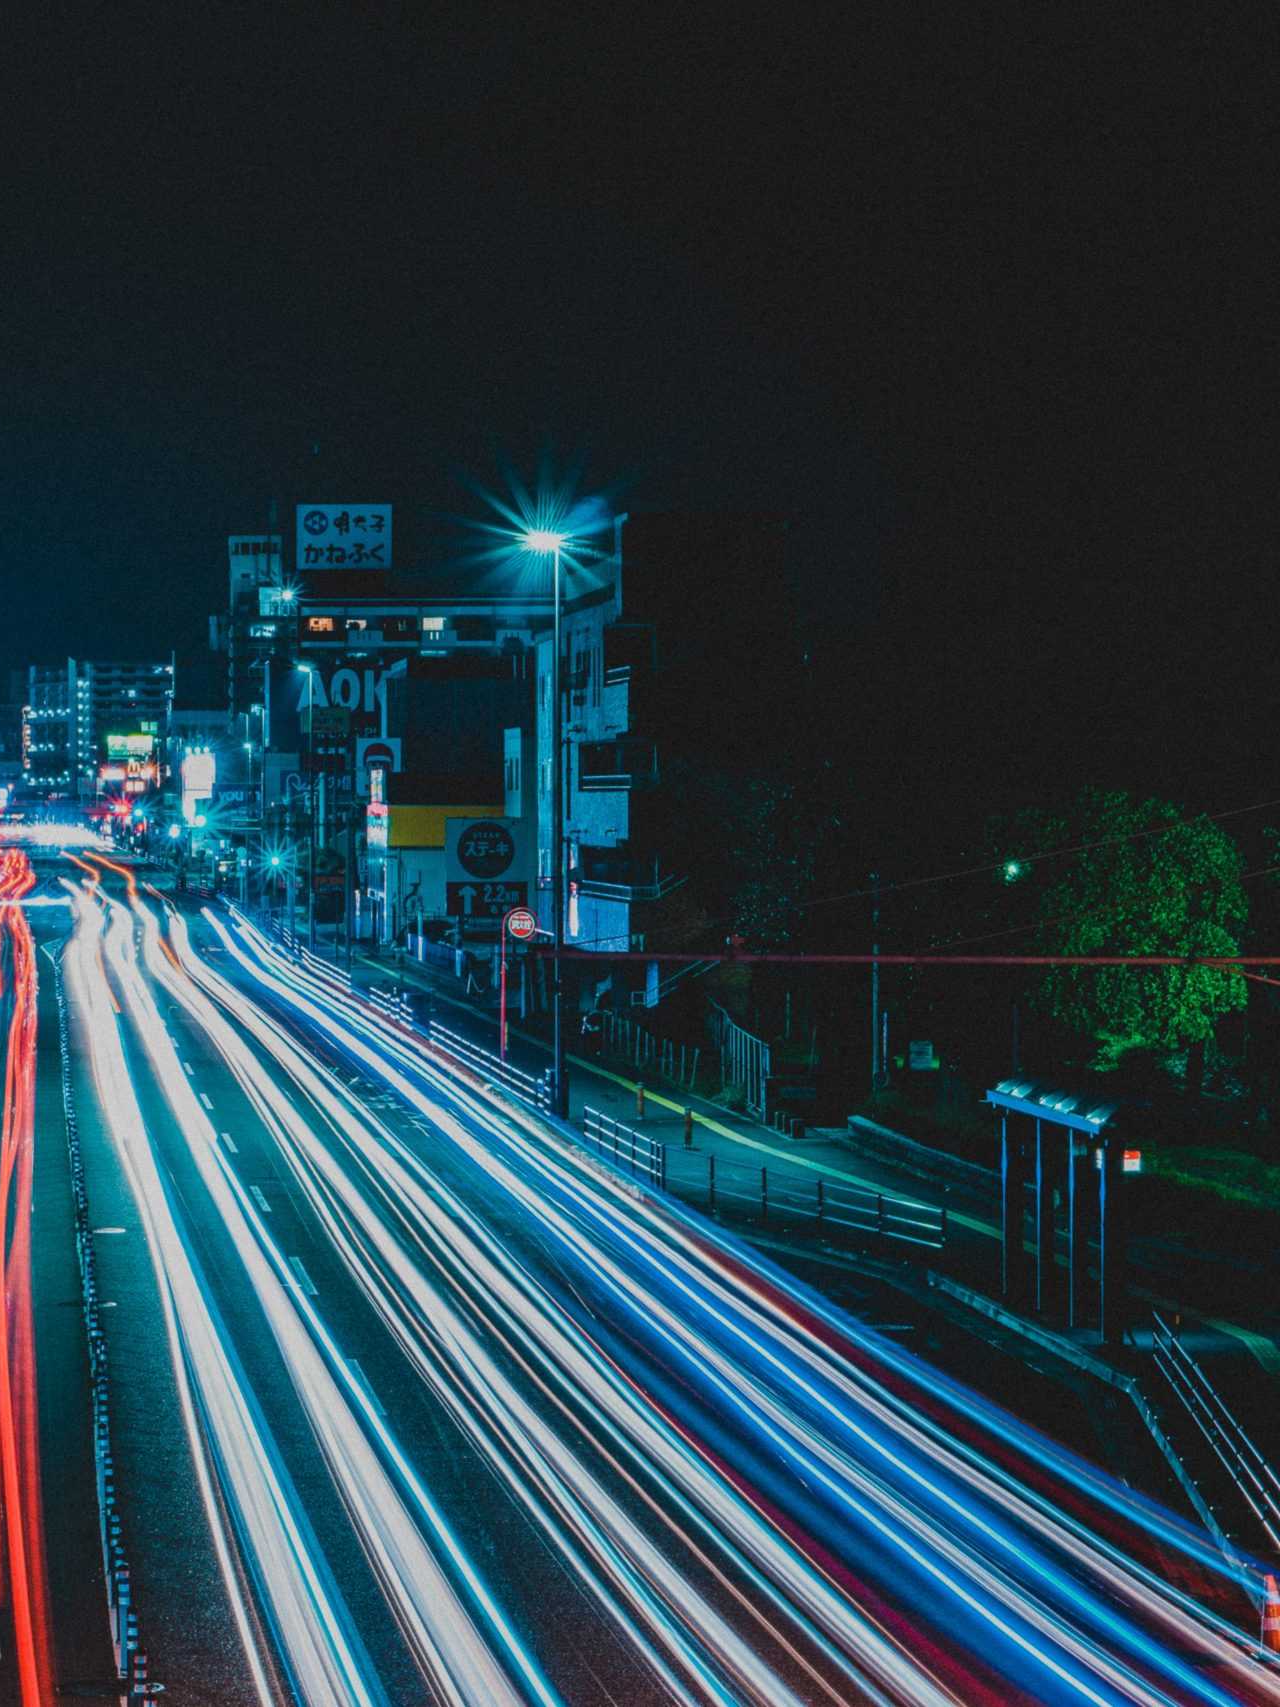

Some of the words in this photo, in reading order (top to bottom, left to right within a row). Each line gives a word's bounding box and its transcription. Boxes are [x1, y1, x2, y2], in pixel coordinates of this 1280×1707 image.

[304, 543, 385, 564] かねふく
[464, 841, 510, 857] ステーキ
